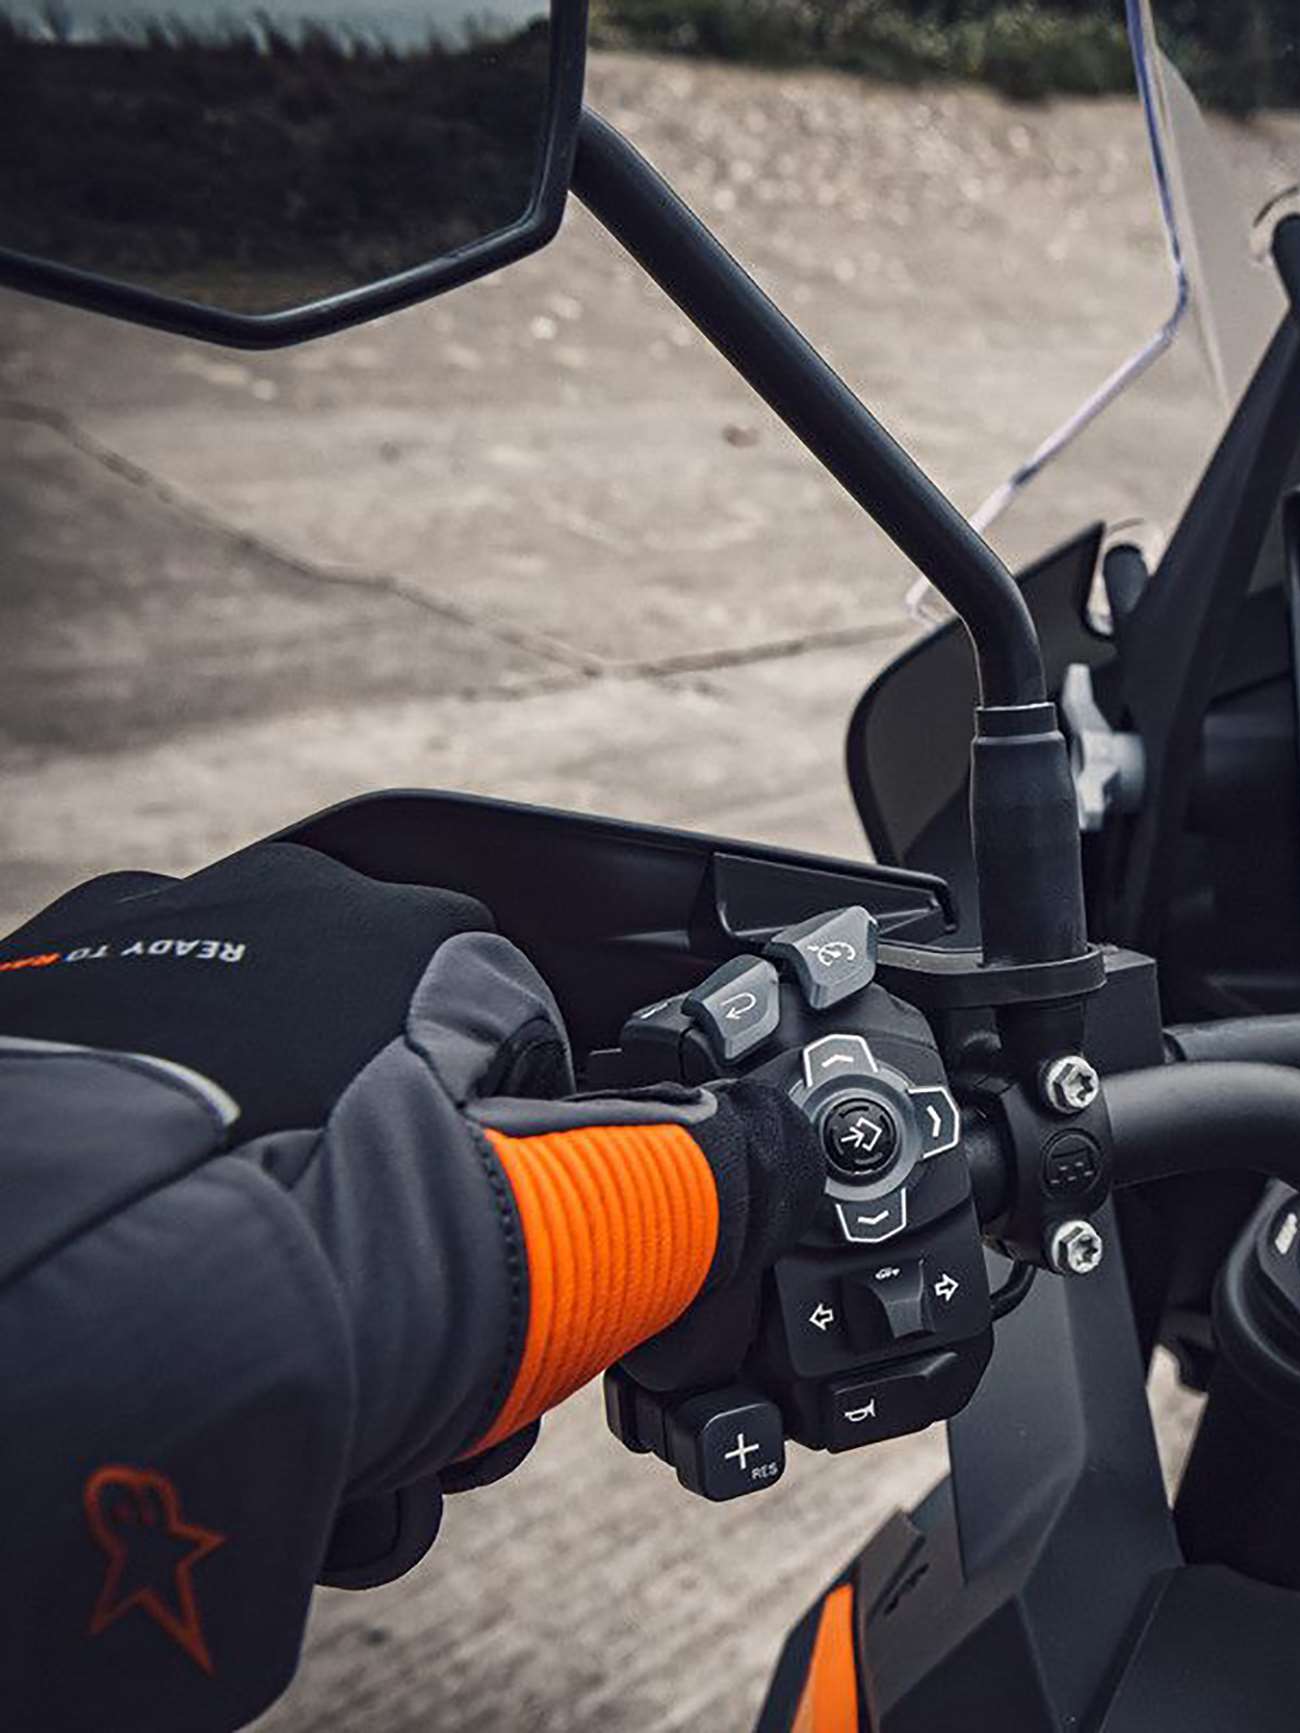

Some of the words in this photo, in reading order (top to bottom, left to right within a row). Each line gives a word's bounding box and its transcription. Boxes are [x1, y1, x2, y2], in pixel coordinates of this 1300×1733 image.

[65, 944, 110, 962] TO
[121, 940, 246, 962] READY
[751, 1462, 778, 1479] RES
